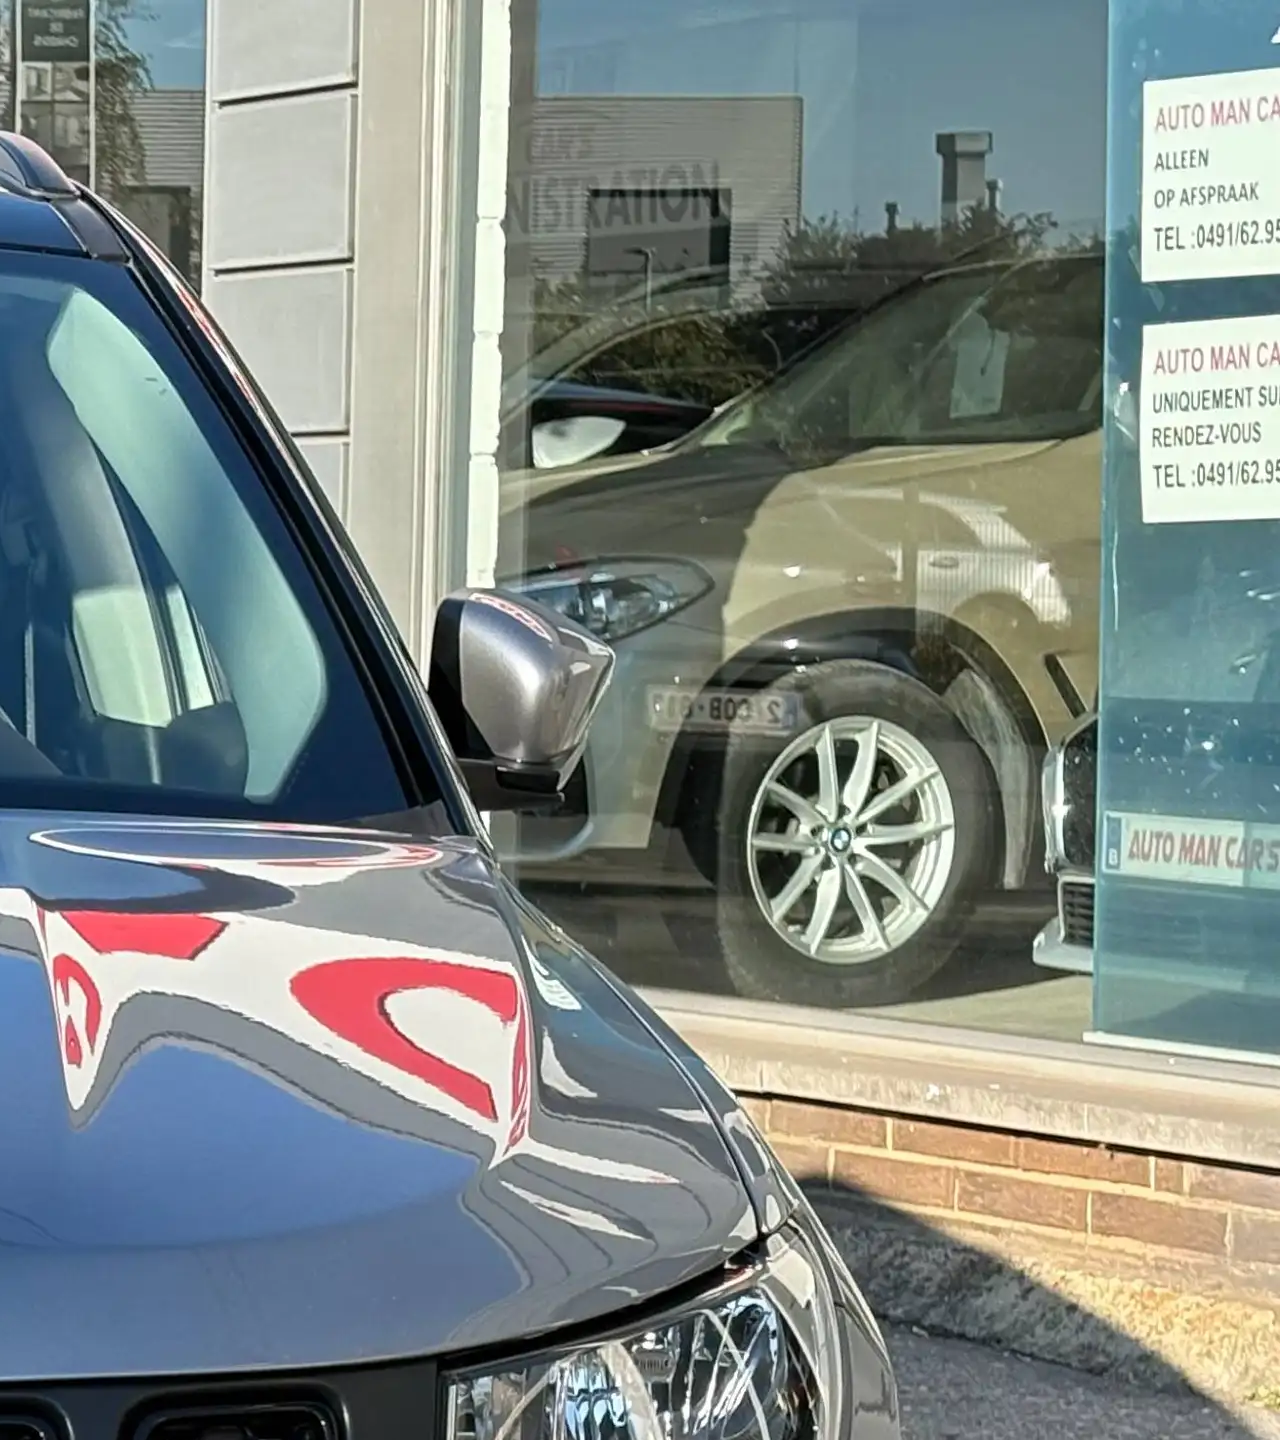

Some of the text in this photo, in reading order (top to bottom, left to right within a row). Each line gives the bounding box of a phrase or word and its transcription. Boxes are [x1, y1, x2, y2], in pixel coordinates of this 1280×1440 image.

[1154, 103, 1205, 133] AUTO
[1210, 98, 1251, 127] MAN
[1154, 148, 1210, 172] ALLEEN
[1154, 181, 1260, 209] OP AFSPRAAK
[1153, 225, 1185, 252] TEL
[1153, 347, 1204, 375] AUTO
[1210, 343, 1250, 371] MAN
[1152, 383, 1280, 413] UNIQUEMENT SU
[1152, 421, 1262, 448] RENDEZ-VOUS
[1152, 464, 1186, 490] TEL
[1127, 829, 1175, 864] AUTO
[1178, 832, 1222, 869] MAN
